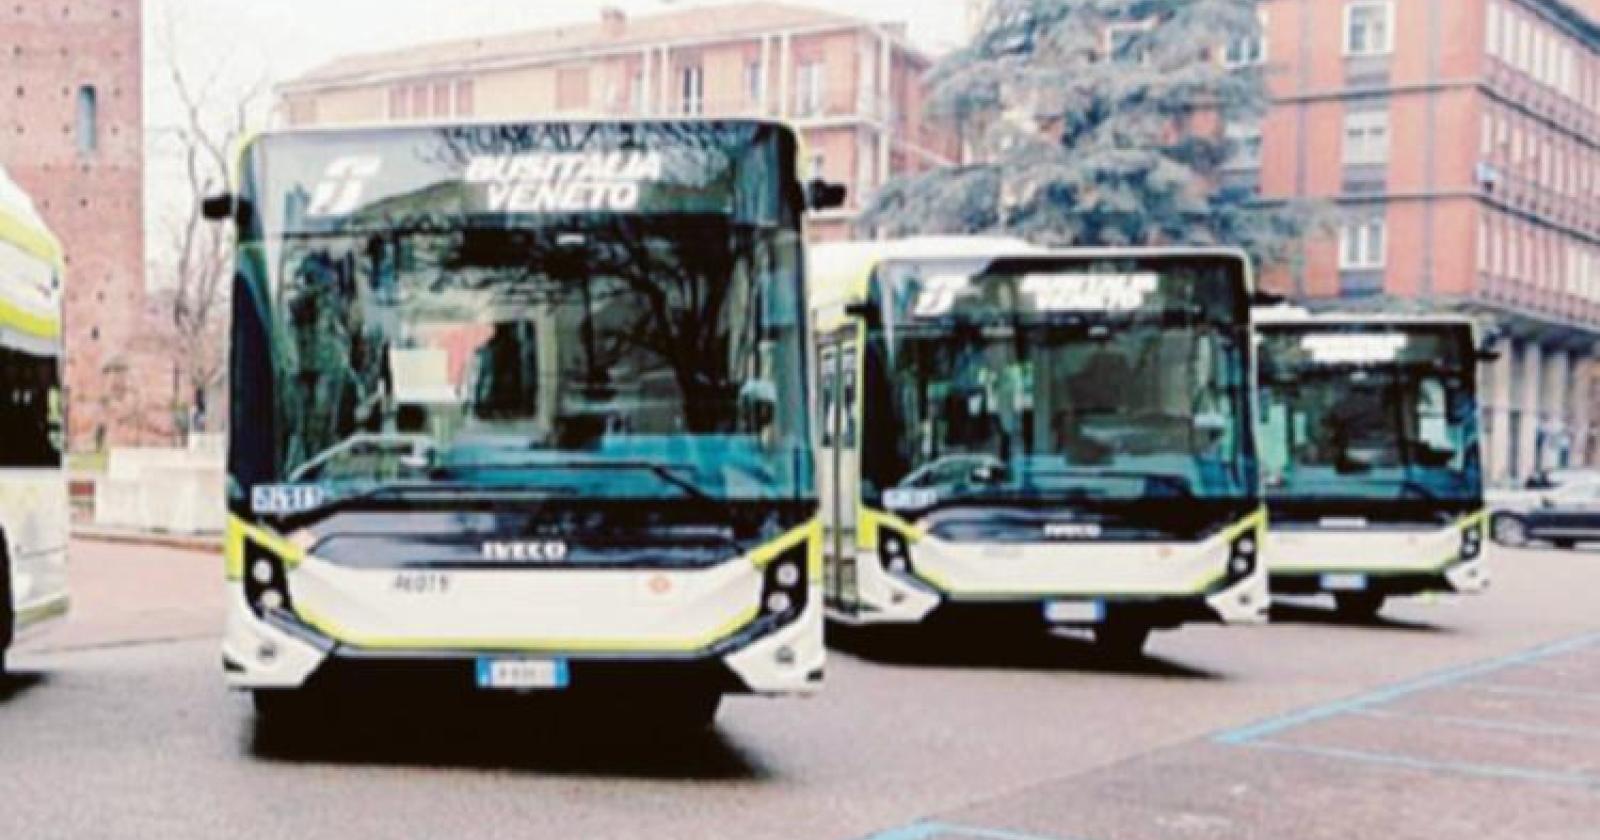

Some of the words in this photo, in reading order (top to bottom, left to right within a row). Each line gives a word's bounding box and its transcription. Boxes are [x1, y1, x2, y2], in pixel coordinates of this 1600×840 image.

[465, 152, 662, 181] BUSITALIA
[487, 180, 639, 212] VENETO
[482, 541, 567, 560] IVECO
